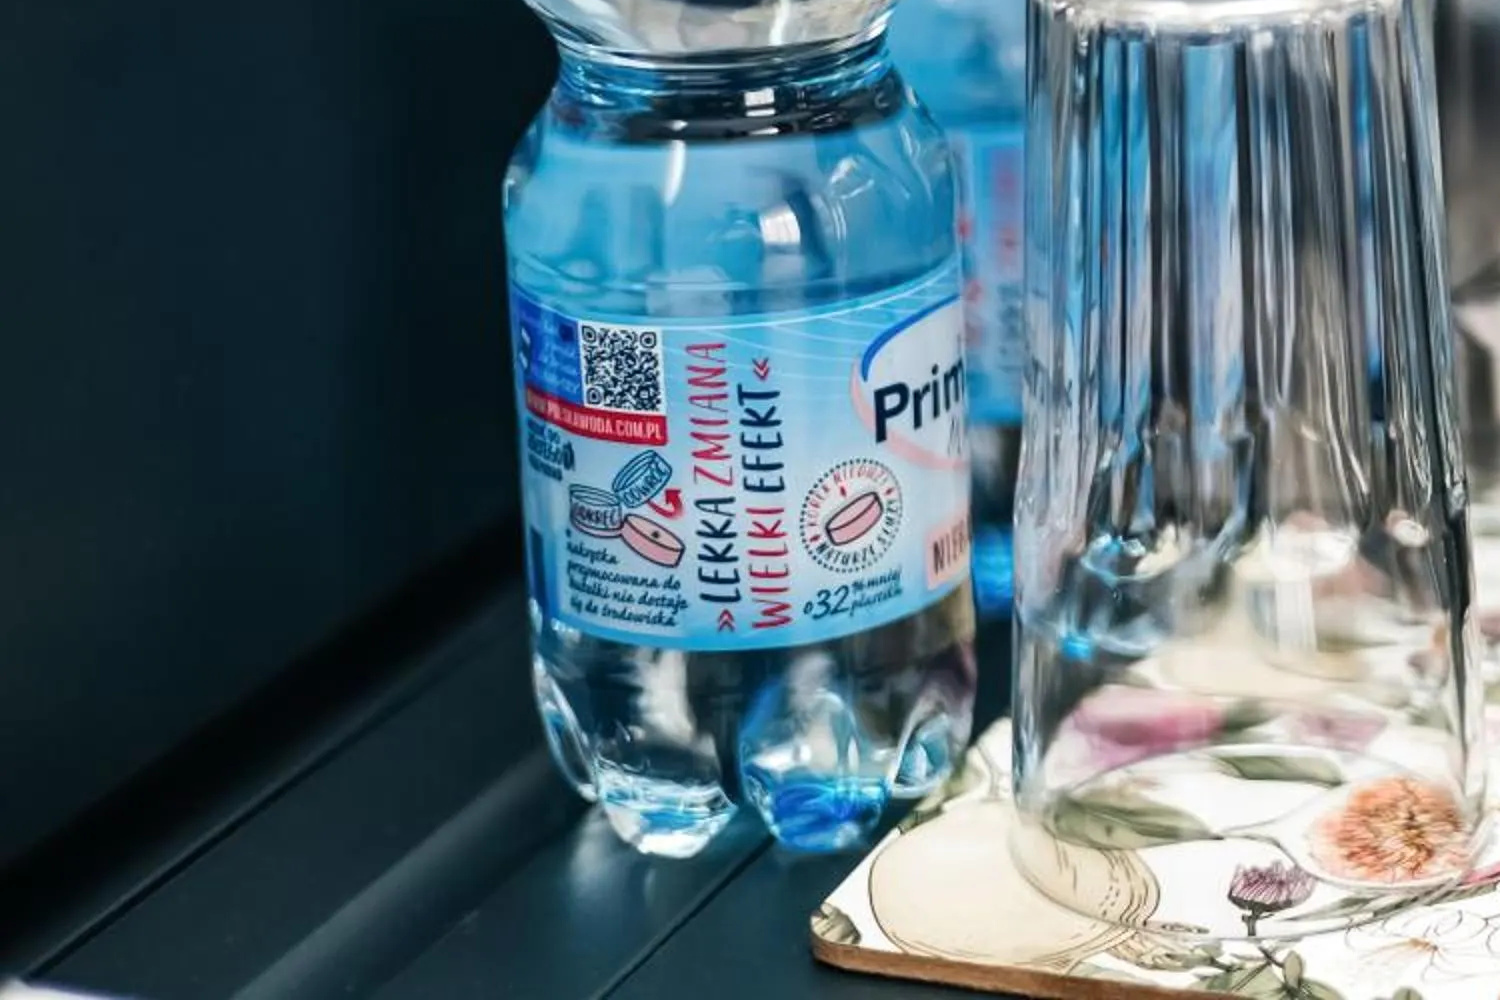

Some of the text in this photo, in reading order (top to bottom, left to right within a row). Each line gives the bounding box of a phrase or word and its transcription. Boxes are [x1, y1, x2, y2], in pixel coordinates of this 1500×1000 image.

[685, 342, 742, 602] LEKKA ZMIANA
[737, 383, 794, 629] WIELKI EFEKT
[612, 589, 635, 603] nie
[662, 573, 681, 590] do
